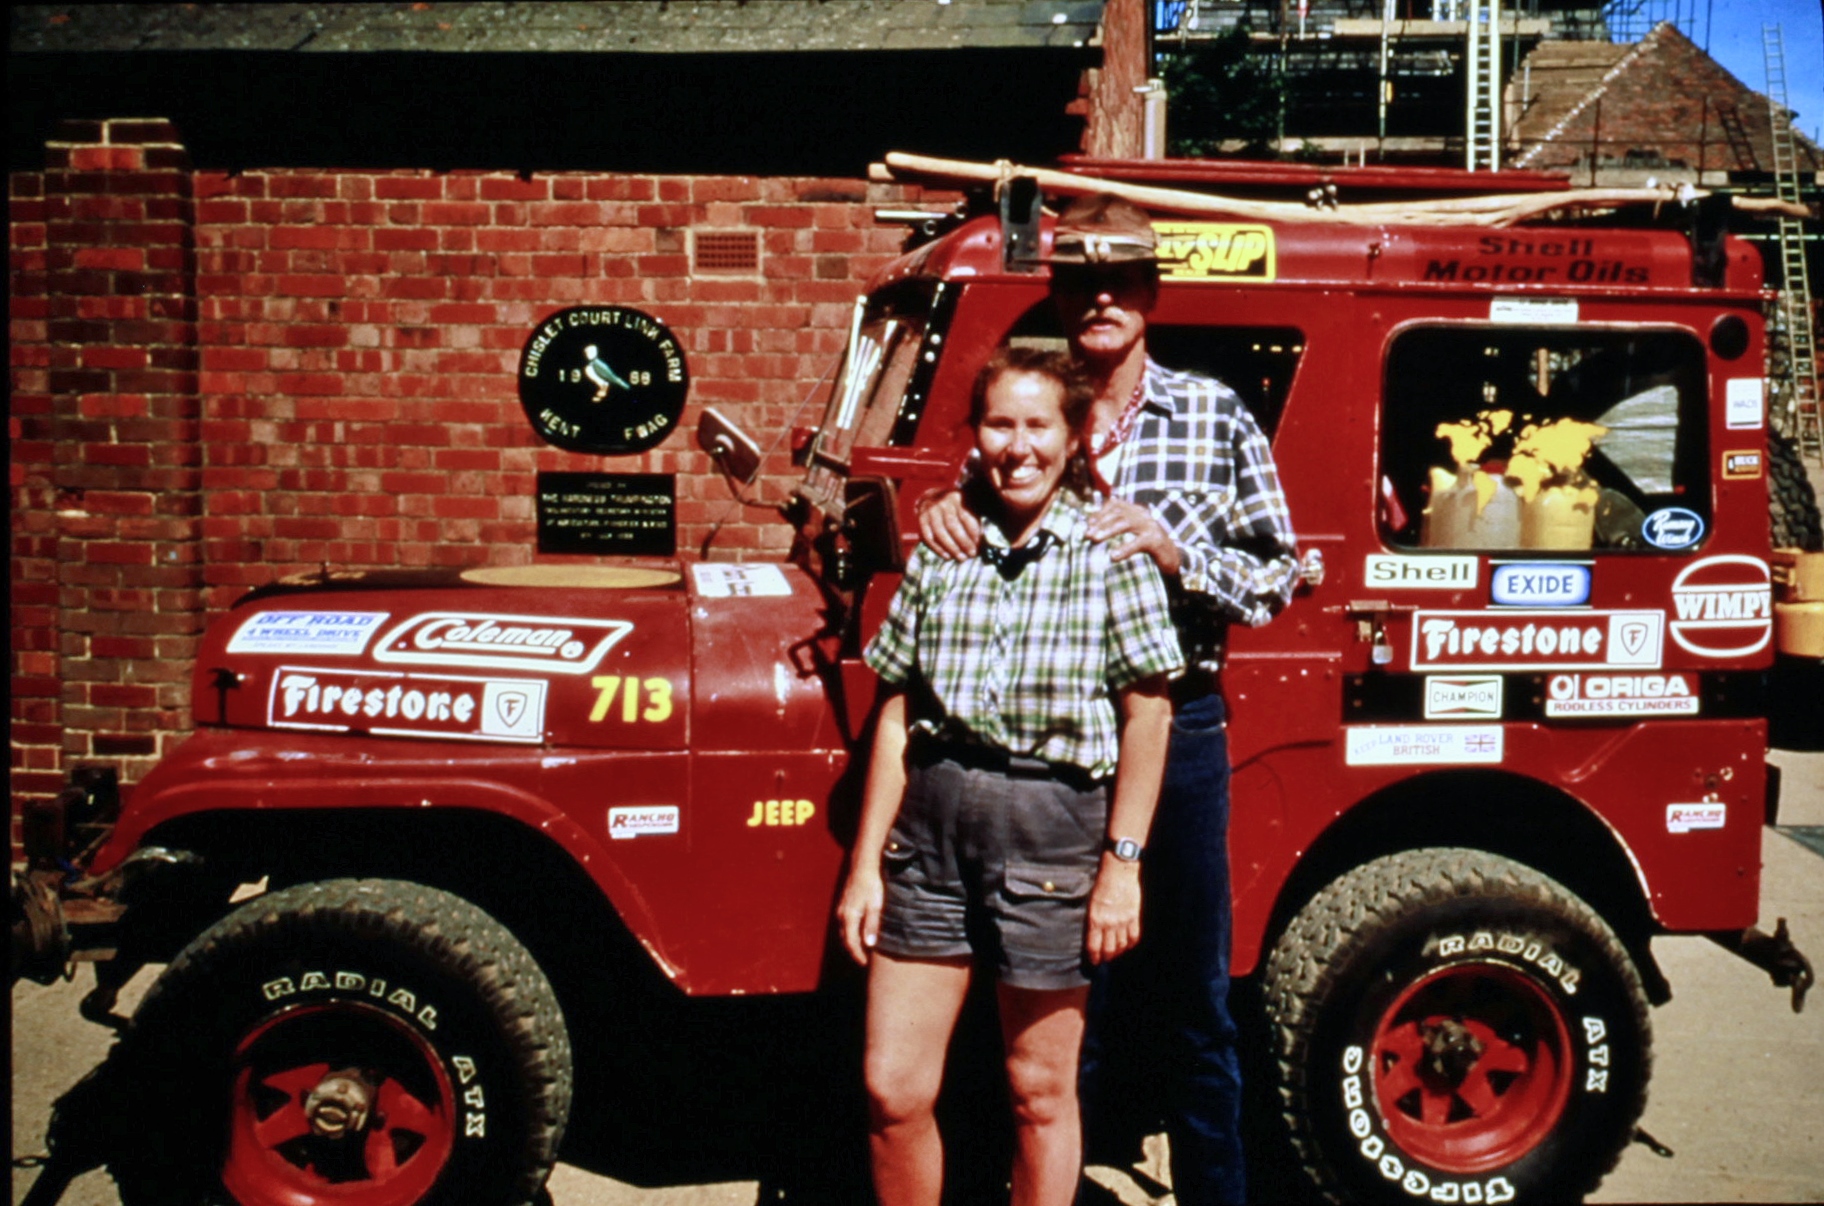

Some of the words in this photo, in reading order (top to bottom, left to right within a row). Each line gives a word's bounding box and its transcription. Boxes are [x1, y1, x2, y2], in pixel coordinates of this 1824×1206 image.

[1479, 236, 1593, 256] Shell
[1424, 259, 1557, 282] Motor
[1566, 259, 1650, 283] Oils
[525, 317, 564, 378] CHISLET
[568, 311, 621, 327] COURT
[624, 314, 660, 341] LINK
[658, 339, 682, 382] FARM
[539, 408, 581, 438] KENT
[1372, 561, 1469, 581] Shell
[1507, 574, 1574, 595] EXIDE
[1673, 590, 1771, 620] WIMPY
[257, 613, 305, 625] OFF
[308, 614, 375, 626] ROAD
[260, 628, 311, 637] WHEEL
[316, 629, 363, 638] DRIVE
[414, 618, 573, 650] Coleman
[1421, 619, 1602, 661] Firestone
[280, 674, 475, 723] Firestone
[589, 675, 673, 723] 713
[1433, 691, 1494, 703] CHAMPION
[1585, 675, 1690, 698] ORIGA
[1554, 701, 1614, 712] RODLESS
[1618, 699, 1692, 711] CYLINDERS
[1378, 733, 1410, 745] LAND
[1415, 733, 1454, 745] ROVER
[1393, 745, 1441, 757] BRITISH
[611, 812, 676, 828] RANCHO
[746, 799, 815, 827] JEEP
[1438, 932, 1582, 995] RADIAL
[262, 970, 438, 1030] RADIAL
[1582, 1016, 1610, 1094] ATX
[452, 1055, 485, 1138] ATX
